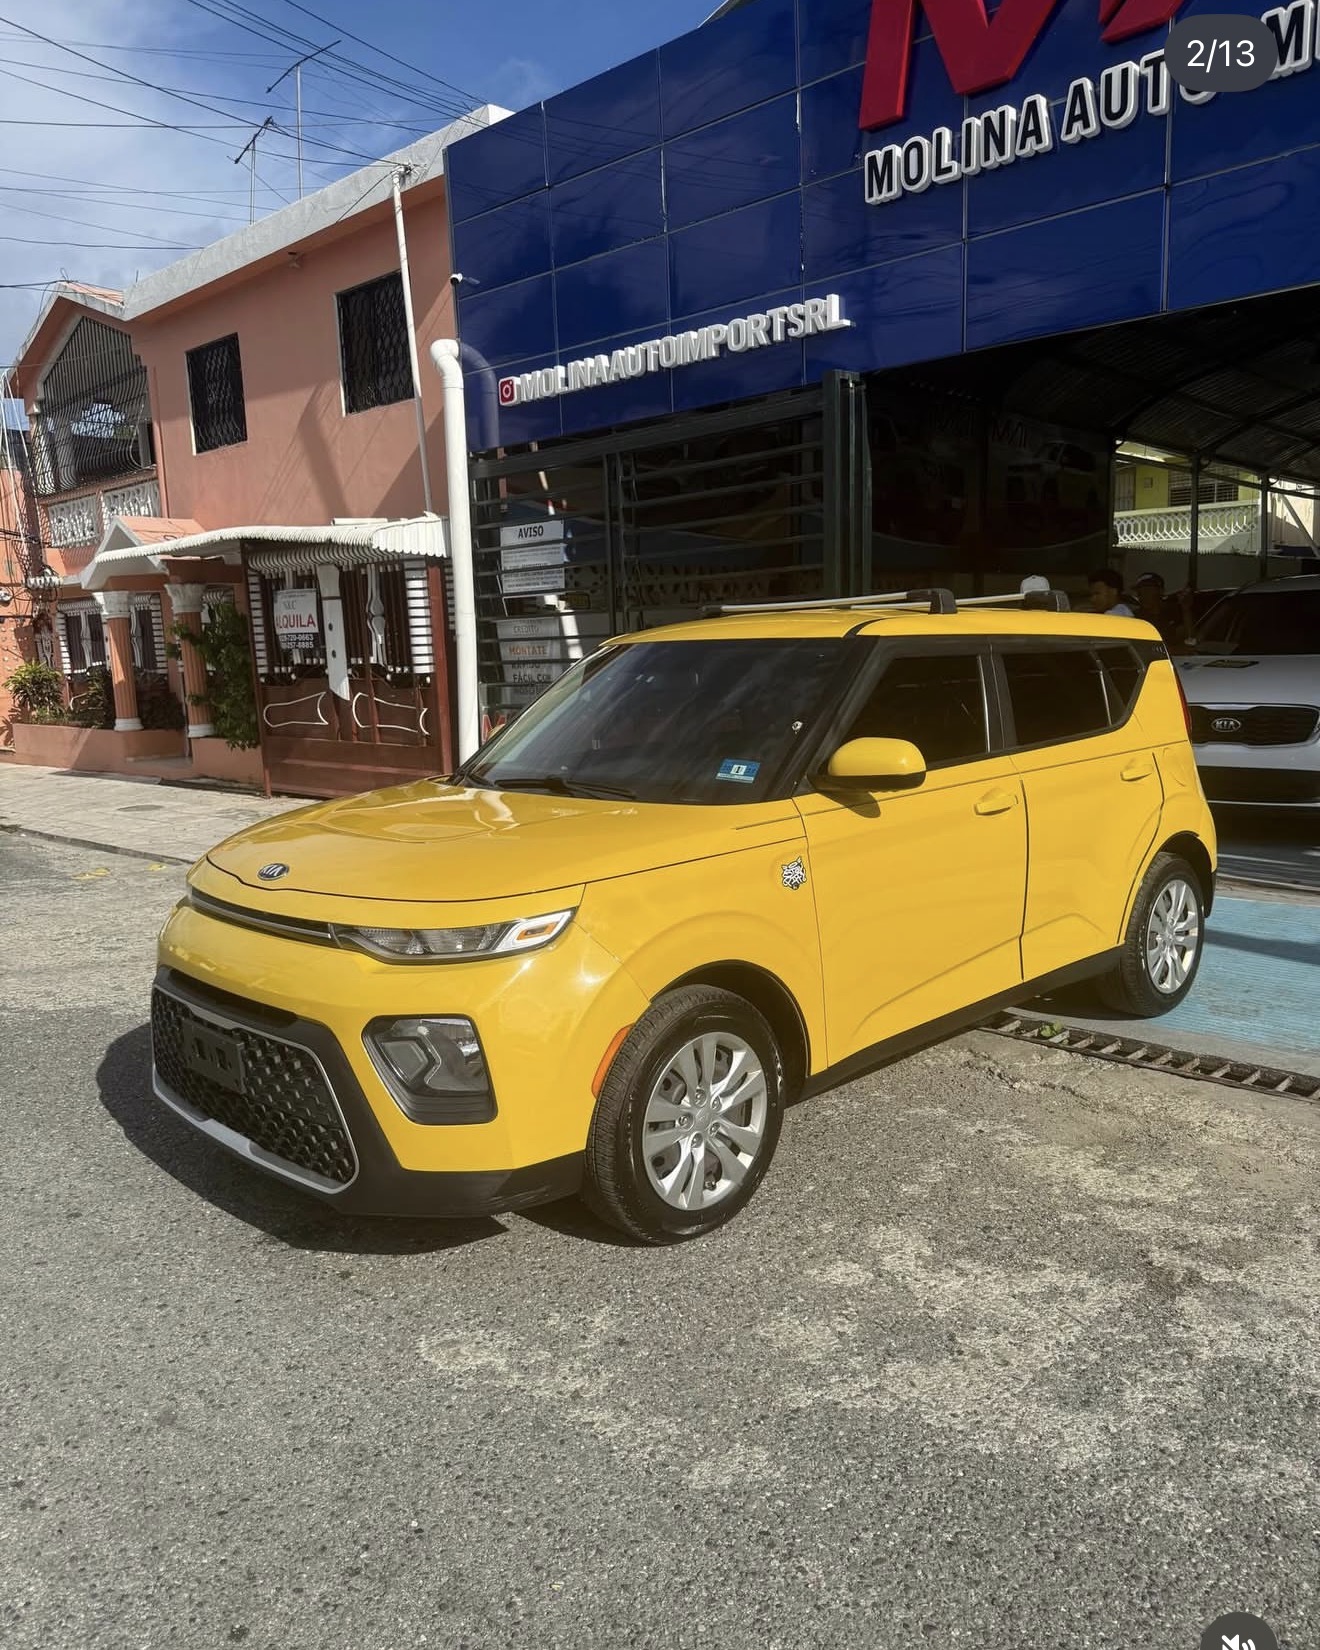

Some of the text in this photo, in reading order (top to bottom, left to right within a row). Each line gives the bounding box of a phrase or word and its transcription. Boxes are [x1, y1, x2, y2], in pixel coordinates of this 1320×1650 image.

[864, 94, 1053, 204] MOLINA
[1060, 48, 1217, 144] AUT
[518, 293, 855, 402] MOLINAAUTOIMPORTSRL
[518, 525, 544, 539] AVISO
